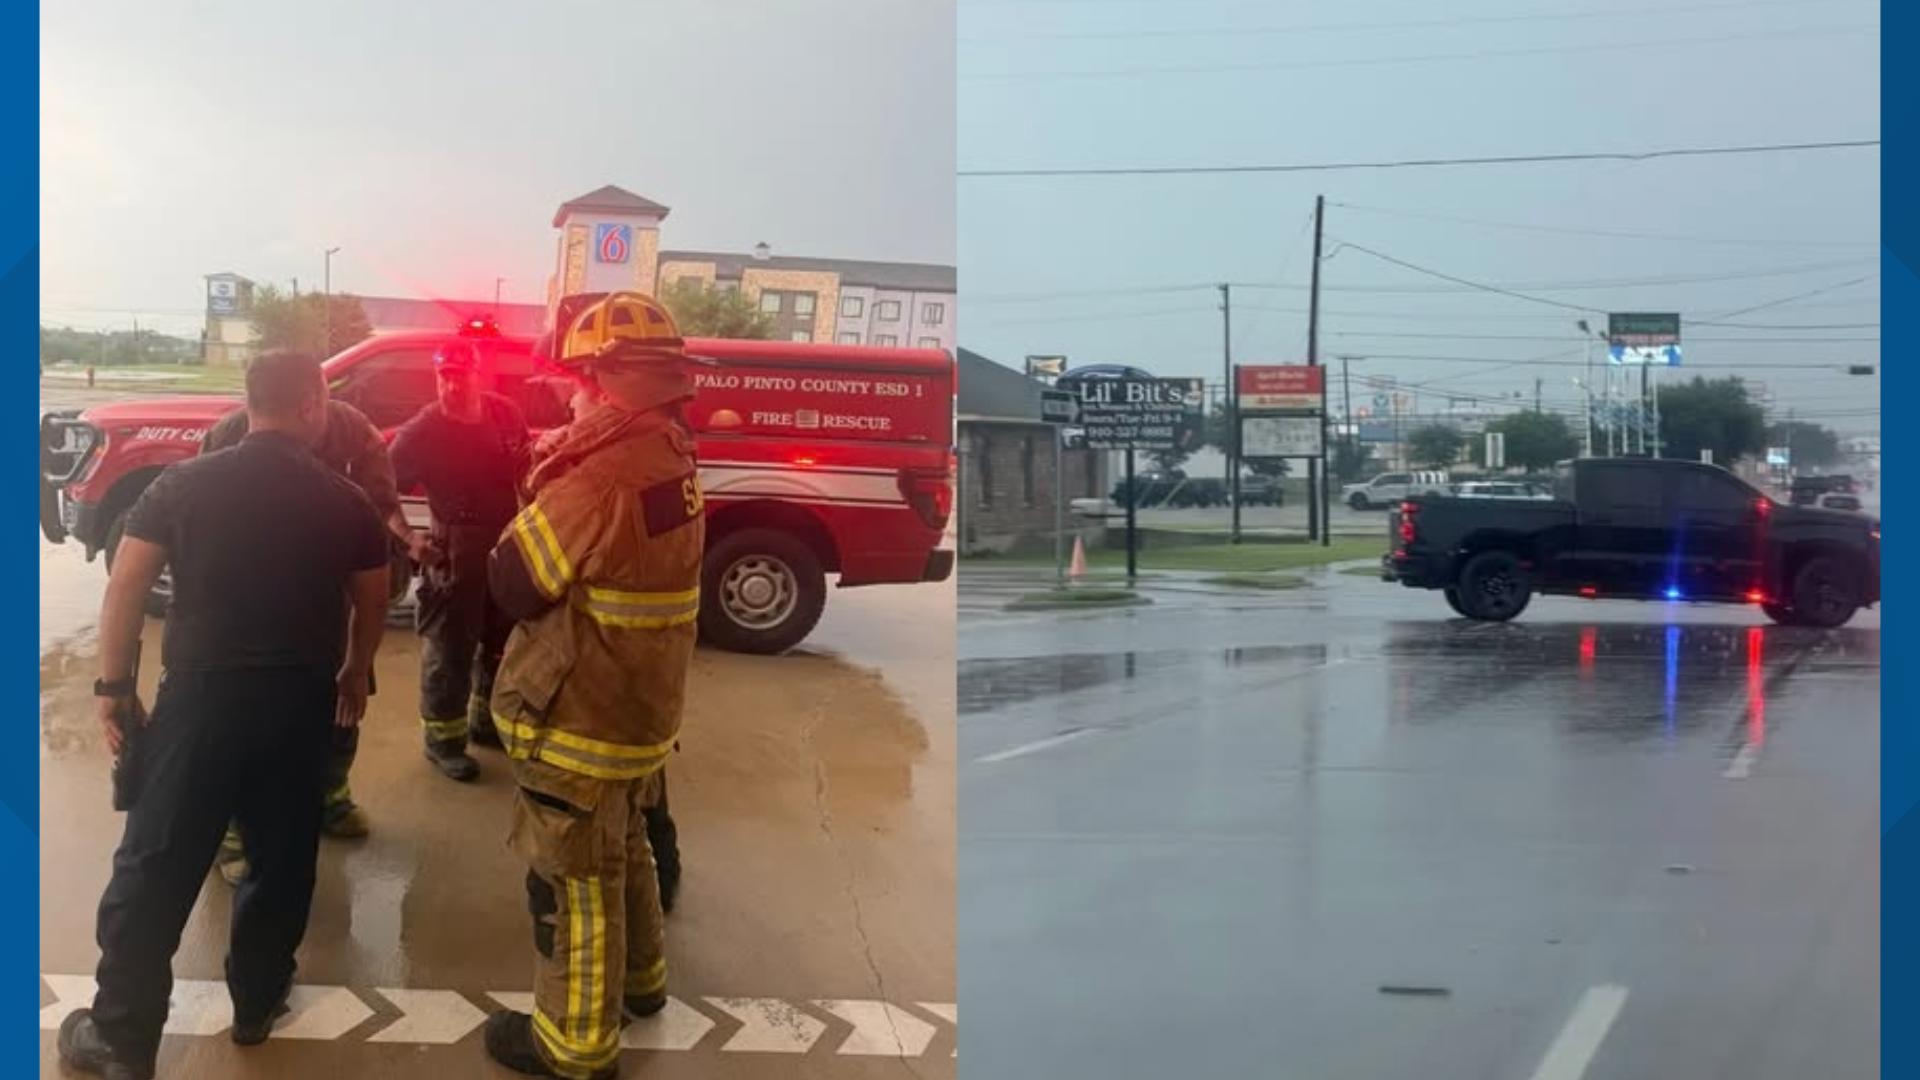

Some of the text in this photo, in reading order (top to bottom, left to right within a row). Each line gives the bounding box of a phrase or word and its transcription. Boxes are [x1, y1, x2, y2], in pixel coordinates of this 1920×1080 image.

[601, 225, 629, 262] 6
[694, 374, 922, 397] PALO PINTO COUNTY ESD 1
[1080, 382, 1182, 402] Lil' Bit's
[752, 411, 892, 431] FIRE RESCUE
[134, 426, 181, 441] DUTY
